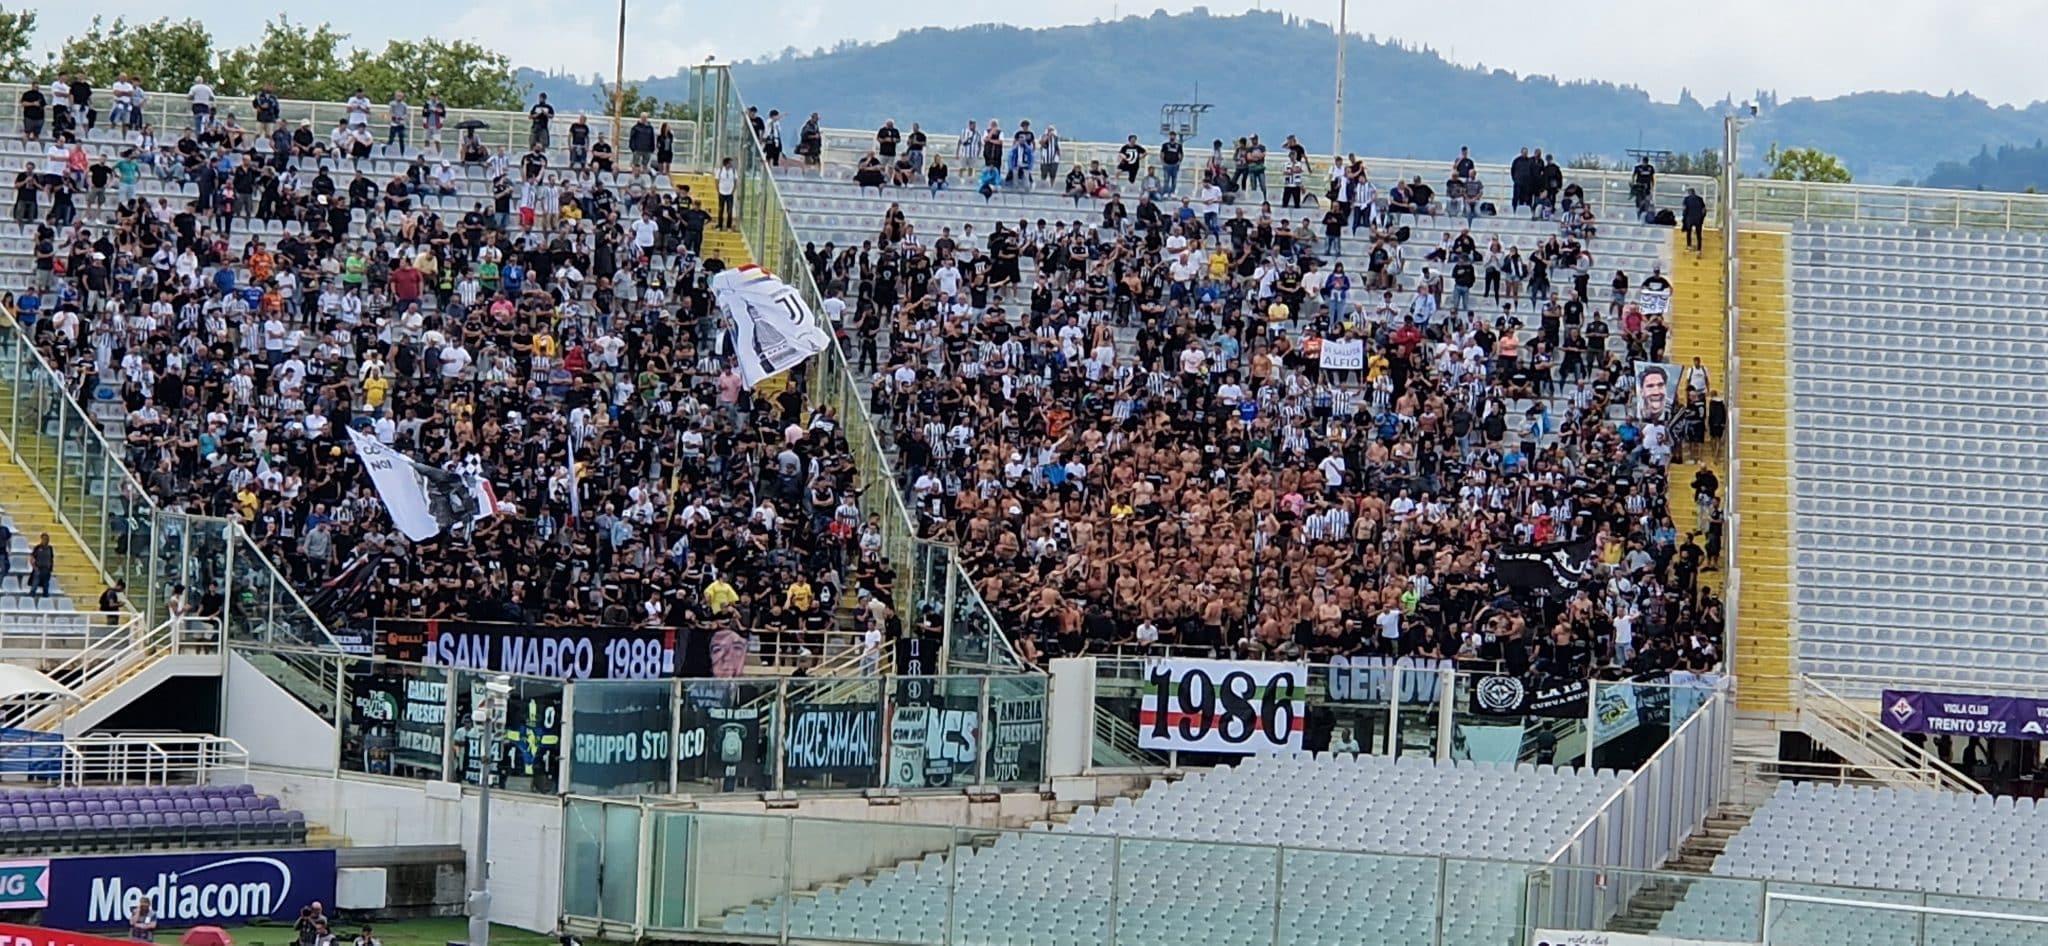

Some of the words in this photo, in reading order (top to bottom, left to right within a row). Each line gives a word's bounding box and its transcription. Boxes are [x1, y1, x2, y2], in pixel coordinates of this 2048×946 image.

[438, 632, 490, 670] SAN
[501, 635, 594, 680] MARCO
[604, 638, 662, 679] 1988
[368, 690, 385, 700] THE
[1536, 687, 1562, 699] LA
[1000, 700, 1042, 720] ANDRIA
[1150, 665, 1295, 745] 1986
[1530, 696, 1566, 710] CURVA
[1943, 703, 1967, 715] VIOLA
[1968, 704, 1989, 716] CLUB
[363, 709, 384, 720] FACE
[406, 702, 446, 723] PRESENT
[1927, 717, 1975, 732] TRENTO
[1976, 720, 2006, 734] 1972
[575, 732, 637, 765] GRUPPO
[641, 727, 704, 764] STOICO
[88, 871, 271, 922] Mediacom
